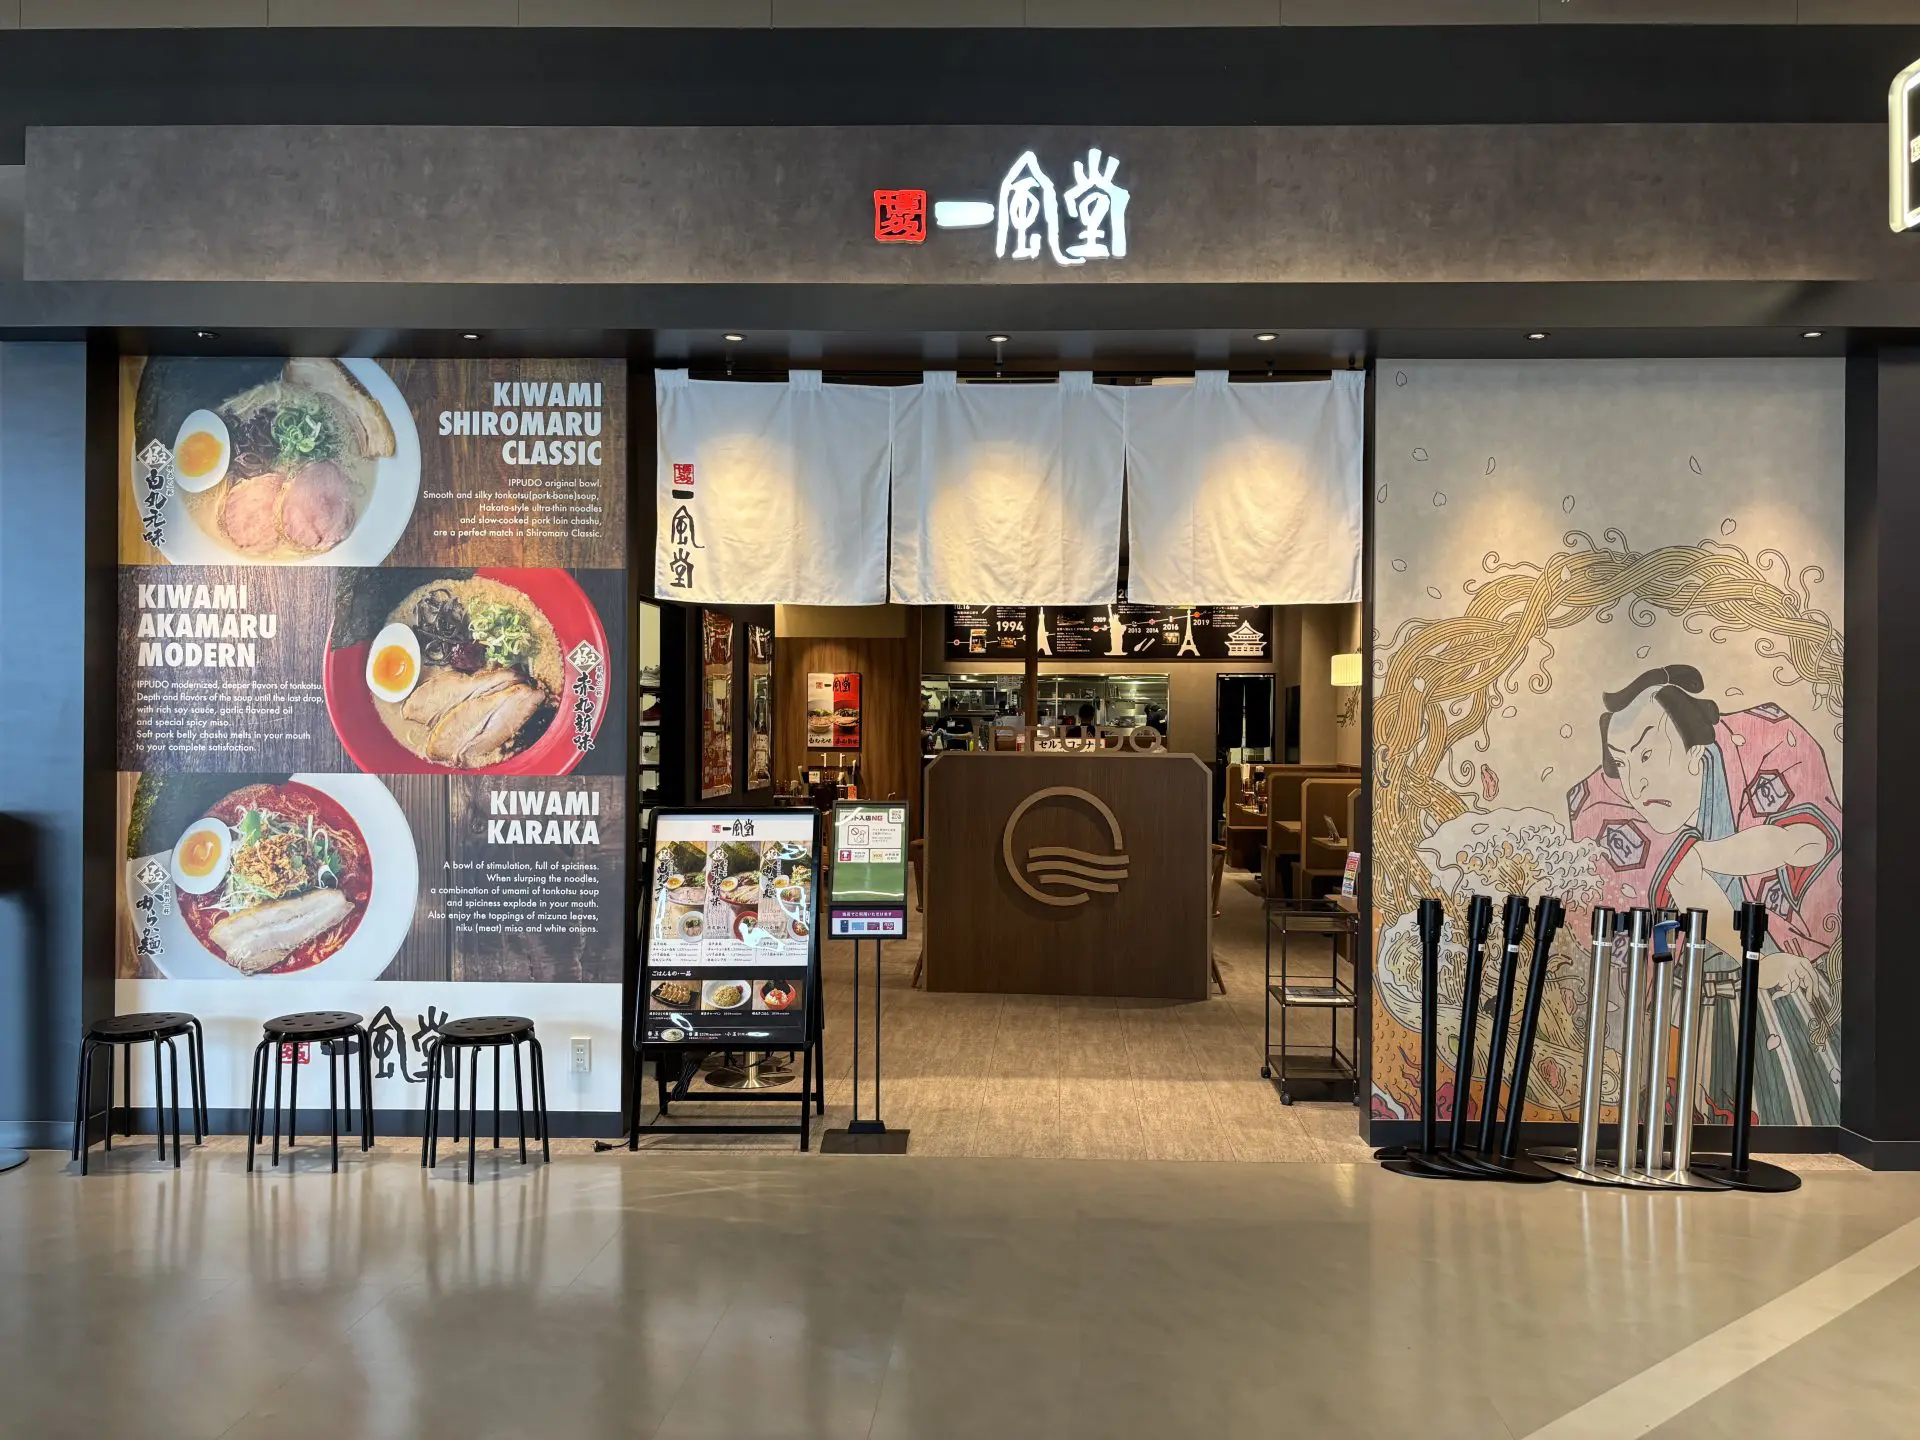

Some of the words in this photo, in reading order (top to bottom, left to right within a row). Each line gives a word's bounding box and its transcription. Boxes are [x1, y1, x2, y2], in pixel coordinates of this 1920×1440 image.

[934, 148, 1130, 266] 一風堂
[494, 383, 601, 406] KIWAMI
[439, 411, 601, 436] SHIROMARU
[503, 440, 601, 465] CLASSIC
[508, 479, 542, 487] IPPUDO
[545, 479, 577, 489] original
[579, 479, 602, 487] bowl.
[423, 491, 453, 499] Smooth
[475, 492, 492, 500] silky
[480, 504, 529, 513] Hakata-style
[532, 504, 567, 512] ultra-thin
[570, 505, 602, 513] noodles
[460, 516, 476, 524] and
[478, 516, 528, 525] slow-cooked
[531, 517, 550, 526] pork
[553, 517, 568, 525] loin
[570, 517, 602, 526] chashu,
[458, 529, 487, 538] perfect
[489, 529, 514, 537] match
[516, 529, 523, 537] in
[526, 529, 568, 537] Shiromaru
[571, 529, 602, 538] Classic.
[670, 488, 705, 588] 一風堂
[138, 585, 247, 609] KIWAMI
[138, 613, 277, 638] AKAMARU
[996, 620, 1024, 632] 1994
[1162, 623, 1179, 631] 2016
[138, 643, 255, 667] MODERN
[172, 681, 220, 690] modernized,
[222, 682, 250, 690] deeper
[252, 681, 278, 689] flavors
[280, 681, 288, 689] of
[290, 682, 324, 690] tonkotsu.
[137, 694, 160, 702] Depth
[219, 694, 231, 702] the
[233, 695, 252, 704] soup
[255, 694, 271, 702] until
[273, 694, 285, 702] the
[287, 694, 301, 702] last
[303, 695, 324, 704] drop,
[174, 707, 188, 716] soy
[191, 707, 217, 715] sauce,
[220, 706, 243, 716] garlic
[245, 706, 280, 715] flavored
[283, 706, 293, 715] oil
[573, 672, 595, 752] 赤丸新味
[137, 718, 153, 726] and
[155, 718, 184, 728] special
[186, 718, 207, 728] spicy
[137, 731, 153, 739] Soft
[155, 731, 174, 740] pork
[177, 731, 197, 740] belly
[199, 731, 228, 739] chashu
[231, 731, 252, 739] melts
[254, 731, 261, 739] in
[264, 732, 283, 741] your
[286, 732, 311, 740] mouth
[136, 743, 144, 751] to
[147, 745, 166, 753] your
[168, 743, 206, 753] complete
[208, 744, 256, 752] satisfaction.
[491, 791, 599, 815] KIWAMI
[488, 820, 600, 844] KARAKA
[722, 818, 754, 837] 一風堂
[453, 862, 473, 870] bowl
[476, 862, 484, 870] of
[486, 862, 532, 871] stimulation,
[535, 862, 548, 870] full
[550, 862, 559, 870] of
[561, 863, 599, 873] spiciness.
[514, 875, 546, 884] slurping
[549, 875, 562, 883] the
[564, 875, 599, 884] noodles,
[491, 887, 500, 895] of
[502, 887, 529, 895] umami
[532, 887, 540, 895] of
[579, 889, 599, 897] soup
[465, 900, 500, 909] spiciness
[503, 900, 537, 909] explode
[539, 900, 547, 908] in
[549, 901, 569, 909] your
[571, 900, 598, 908] mouth.
[448, 912, 470, 921] enjoy
[473, 912, 486, 920] the
[489, 912, 524, 921] toppings
[526, 912, 535, 920] of
[538, 912, 567, 920] mizuna
[570, 913, 599, 922] leaves,
[456, 924, 473, 932] niku
[475, 924, 502, 933] (meat)
[526, 924, 542, 932] and
[544, 924, 567, 932] white
[569, 925, 599, 933] onions.
